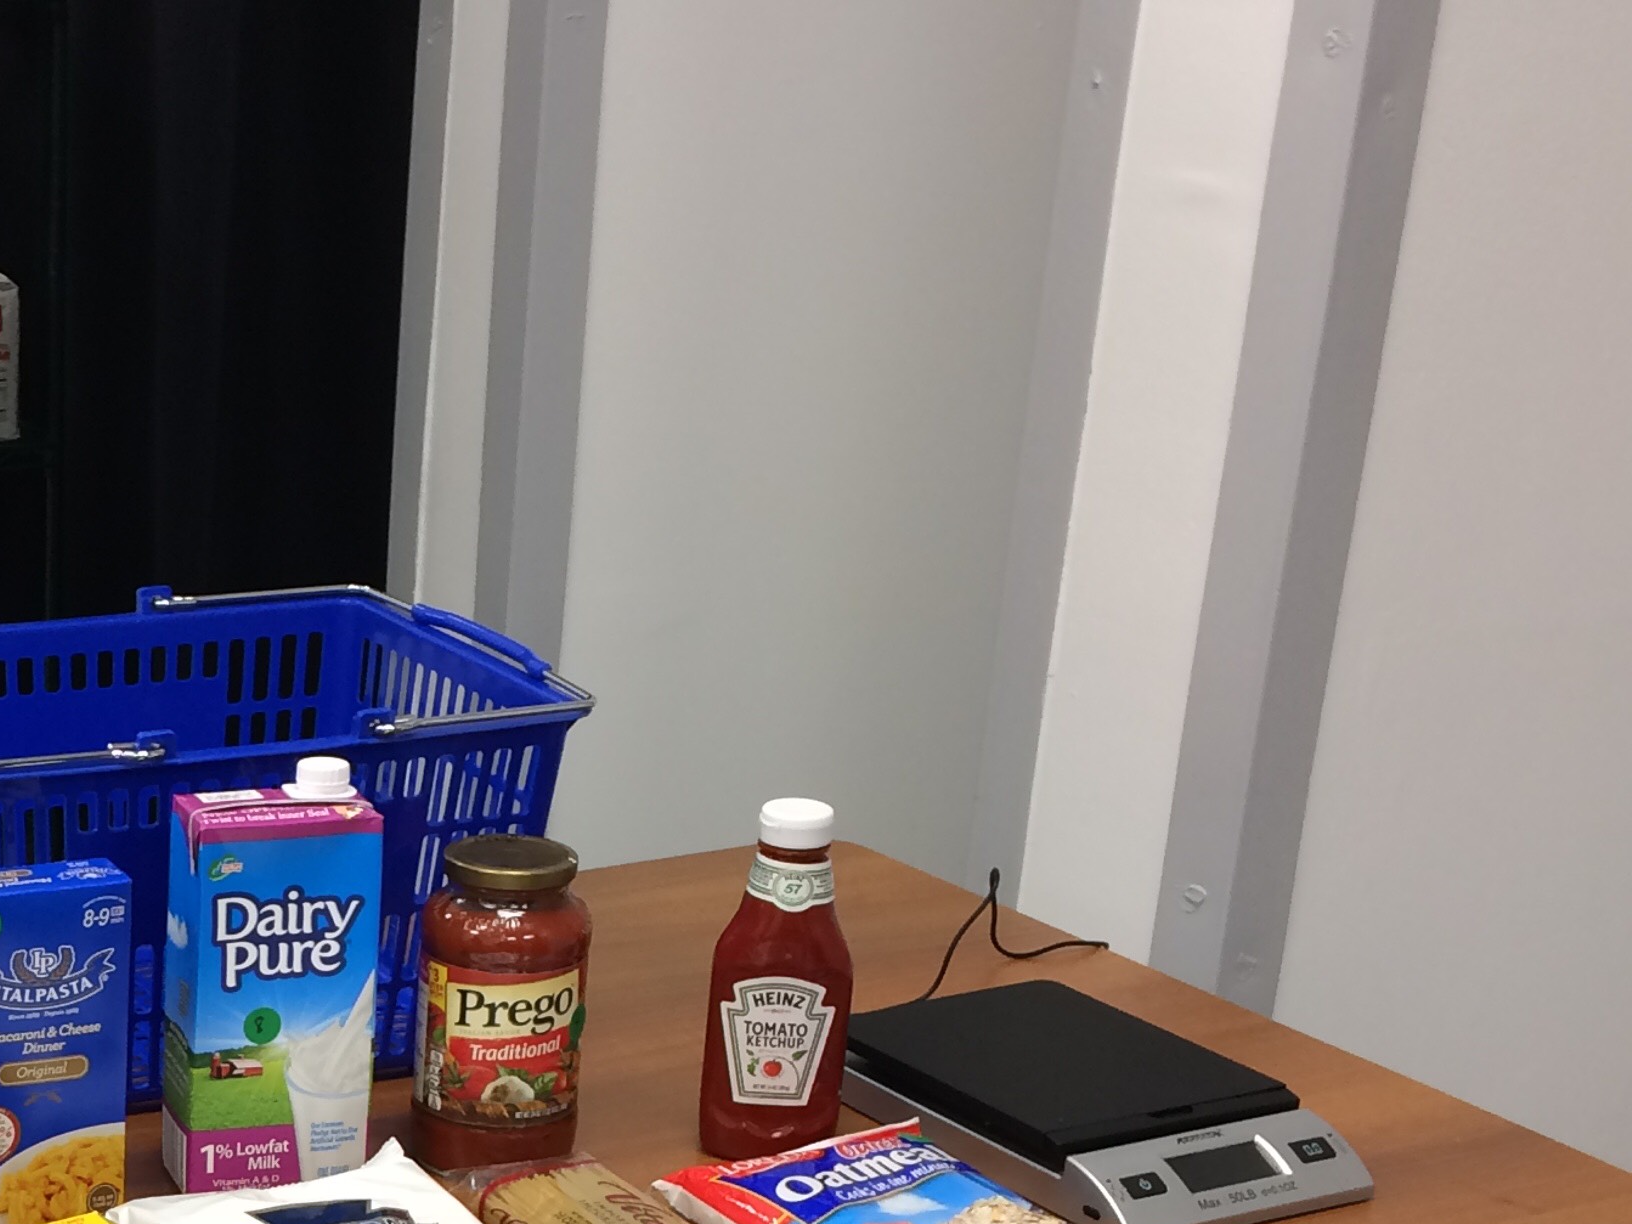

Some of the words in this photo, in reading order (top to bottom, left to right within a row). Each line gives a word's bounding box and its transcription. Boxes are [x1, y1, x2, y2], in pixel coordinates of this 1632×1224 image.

[784, 883, 803, 895] 57
[216, 890, 361, 942] Dairy
[225, 939, 342, 988] Pure
[752, 991, 806, 1009] HEINZ
[454, 983, 574, 1036] Prego
[47, 1025, 58, 1038] &
[59, 1021, 102, 1037] Cheese
[744, 1020, 808, 1038] TOMATO
[22, 1041, 66, 1055] Dinner
[469, 1034, 563, 1062] Traditional
[746, 1035, 805, 1049] KETCHUP
[17, 1060, 68, 1079] Original
[200, 1142, 234, 1174] 1%
[236, 1139, 289, 1156] Lowfat
[248, 1154, 281, 1171] Milk
[212, 1176, 250, 1187] Vitamin
[252, 1176, 260, 1184] A
[271, 1174, 280, 1183] D
[775, 1143, 960, 1202] Oatmeal
[835, 1186, 875, 1202] Cooks
[873, 1180, 890, 1193] in
[890, 1174, 911, 1187] one
[1198, 1197, 1222, 1211] Max
